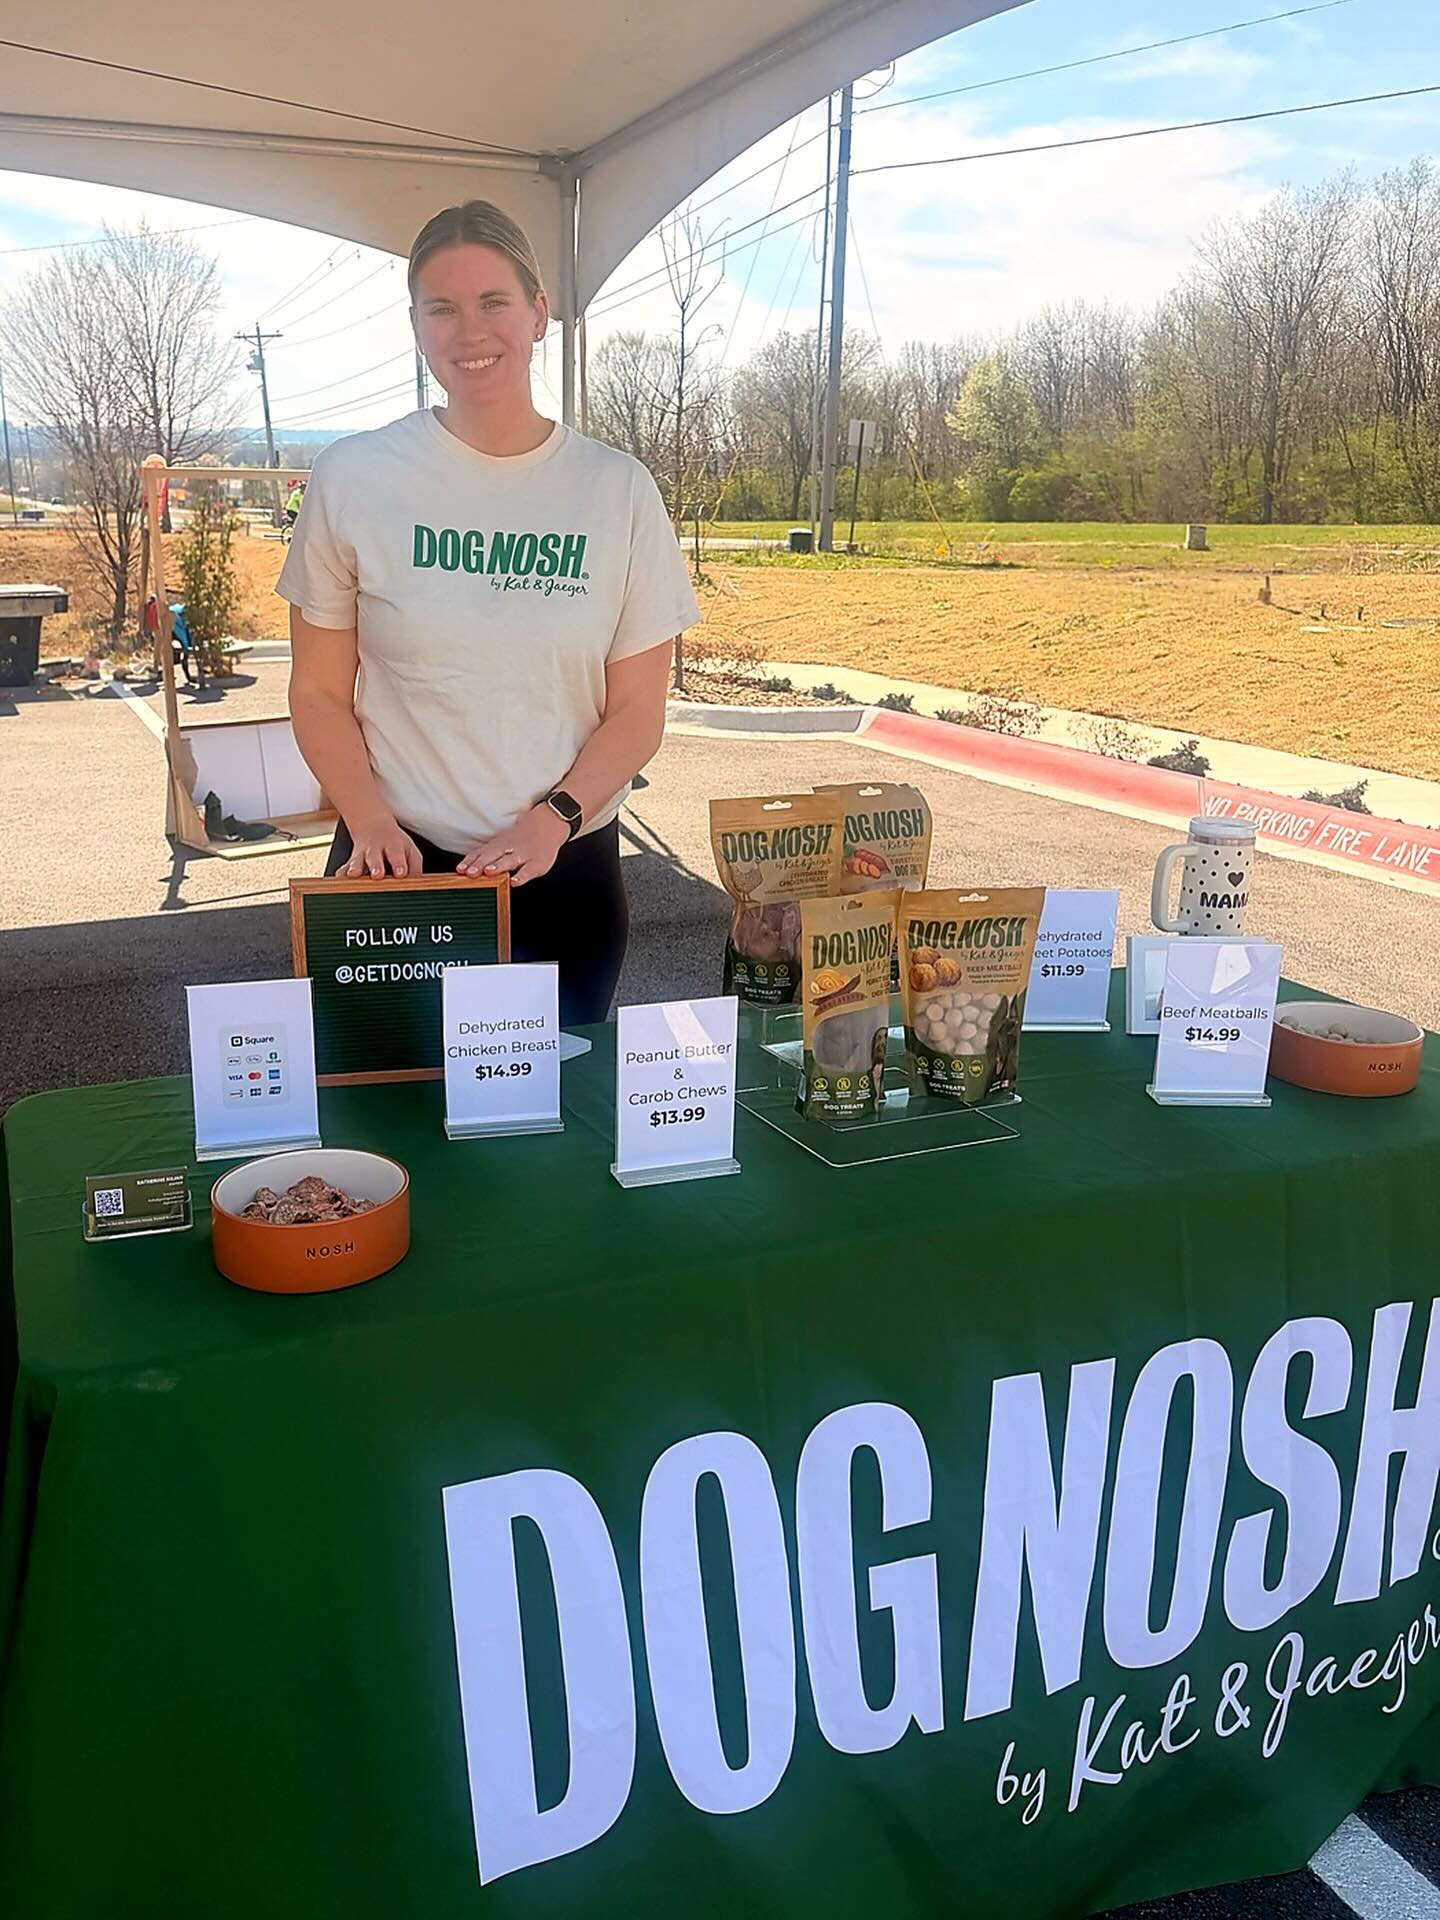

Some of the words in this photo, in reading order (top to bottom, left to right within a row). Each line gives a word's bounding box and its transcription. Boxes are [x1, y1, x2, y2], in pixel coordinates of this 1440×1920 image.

[490, 577, 501, 591] by
[503, 576, 530, 591] Kat
[533, 579, 542, 590] &
[544, 578, 588, 596] Jaeger
[1205, 795, 1232, 817] NO
[1232, 802, 1315, 841] PARKING
[1315, 821, 1373, 856] FIRE
[1371, 836, 1440, 875] LANE
[345, 926, 418, 947] FOLLOW
[431, 925, 453, 943] US
[1037, 930, 1103, 944] ehydrated
[1034, 949, 1054, 958] eet
[1058, 947, 1112, 958] Potatoes
[335, 960, 469, 984] @GETDOGNO
[1041, 964, 1085, 978] $11.99
[1163, 1006, 1198, 1019] Beef
[1199, 1006, 1269, 1020] Meatballs
[458, 1016, 545, 1038] Dehydrated
[1184, 1026, 1241, 1044] $14.99
[244, 1036, 274, 1045] Square
[447, 1043, 507, 1059] Chicken
[511, 1038, 558, 1053] Breast
[625, 1048, 680, 1065] Peanut
[684, 1043, 732, 1058] Butter
[475, 1062, 532, 1082] $14.99
[673, 1068, 684, 1080] &
[1368, 1062, 1402, 1073] NOSH
[628, 1089, 674, 1106] Carob
[677, 1084, 727, 1100] Chews
[649, 1106, 705, 1128] $13.99
[306, 1242, 354, 1258] NOSH
[996, 1741, 1047, 1825] by
[1068, 1674, 1201, 1812] Kat
[1214, 1662, 1251, 1737] &
[1261, 1603, 1440, 1758] Jaeger
